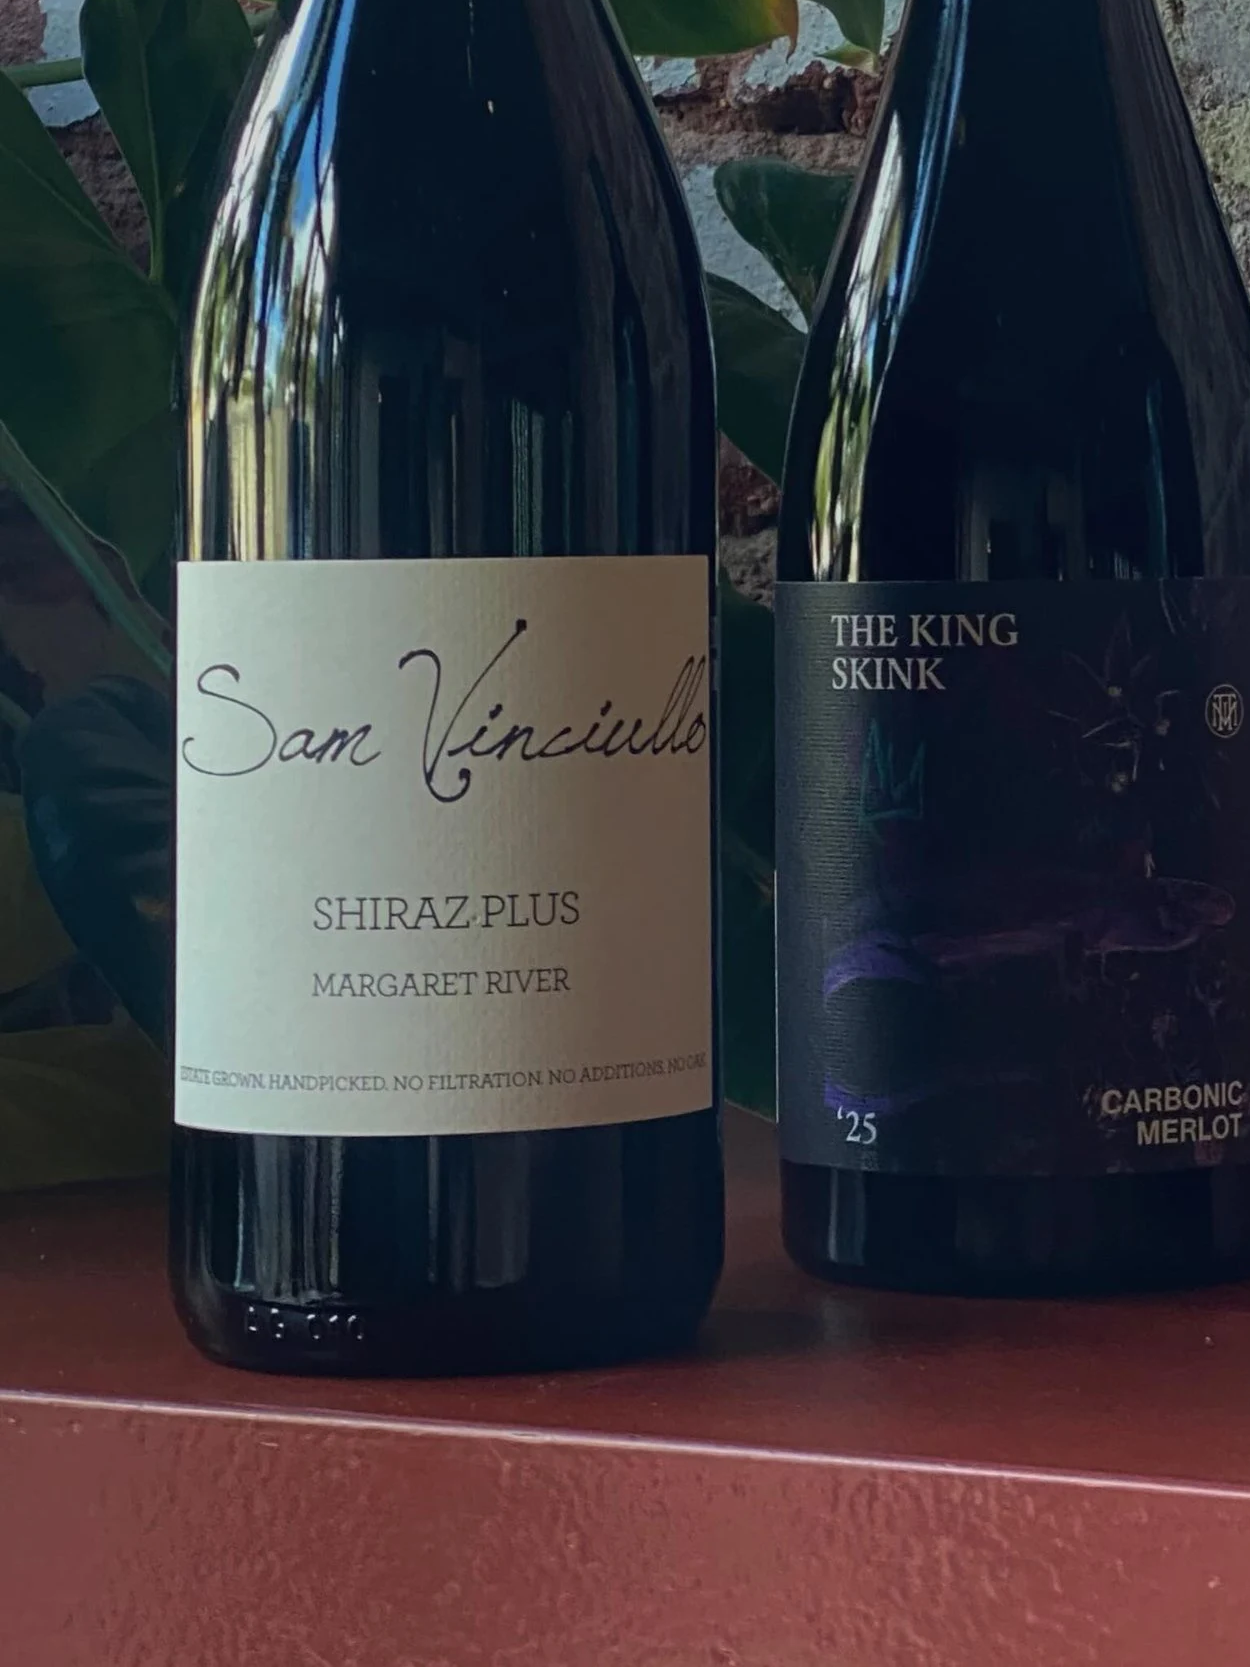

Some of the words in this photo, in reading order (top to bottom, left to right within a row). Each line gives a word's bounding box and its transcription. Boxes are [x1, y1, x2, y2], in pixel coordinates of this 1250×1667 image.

[830, 615, 898, 648] THE
[909, 613, 1019, 647] KING
[830, 656, 946, 691] SKINK
[182, 663, 382, 777] Sam
[399, 618, 707, 804] Vinciullo
[312, 895, 472, 932] SHIRAZ
[480, 890, 582, 929] PLUS
[310, 970, 479, 998] MARGARET
[485, 966, 571, 994] RIVER
[268, 1074, 391, 1092] HANDPICKED.
[393, 1075, 424, 1091] NO
[548, 1068, 576, 1085] NO
[1103, 1080, 1243, 1115] CARBONIC
[1136, 1113, 1244, 1146] MERLOT
